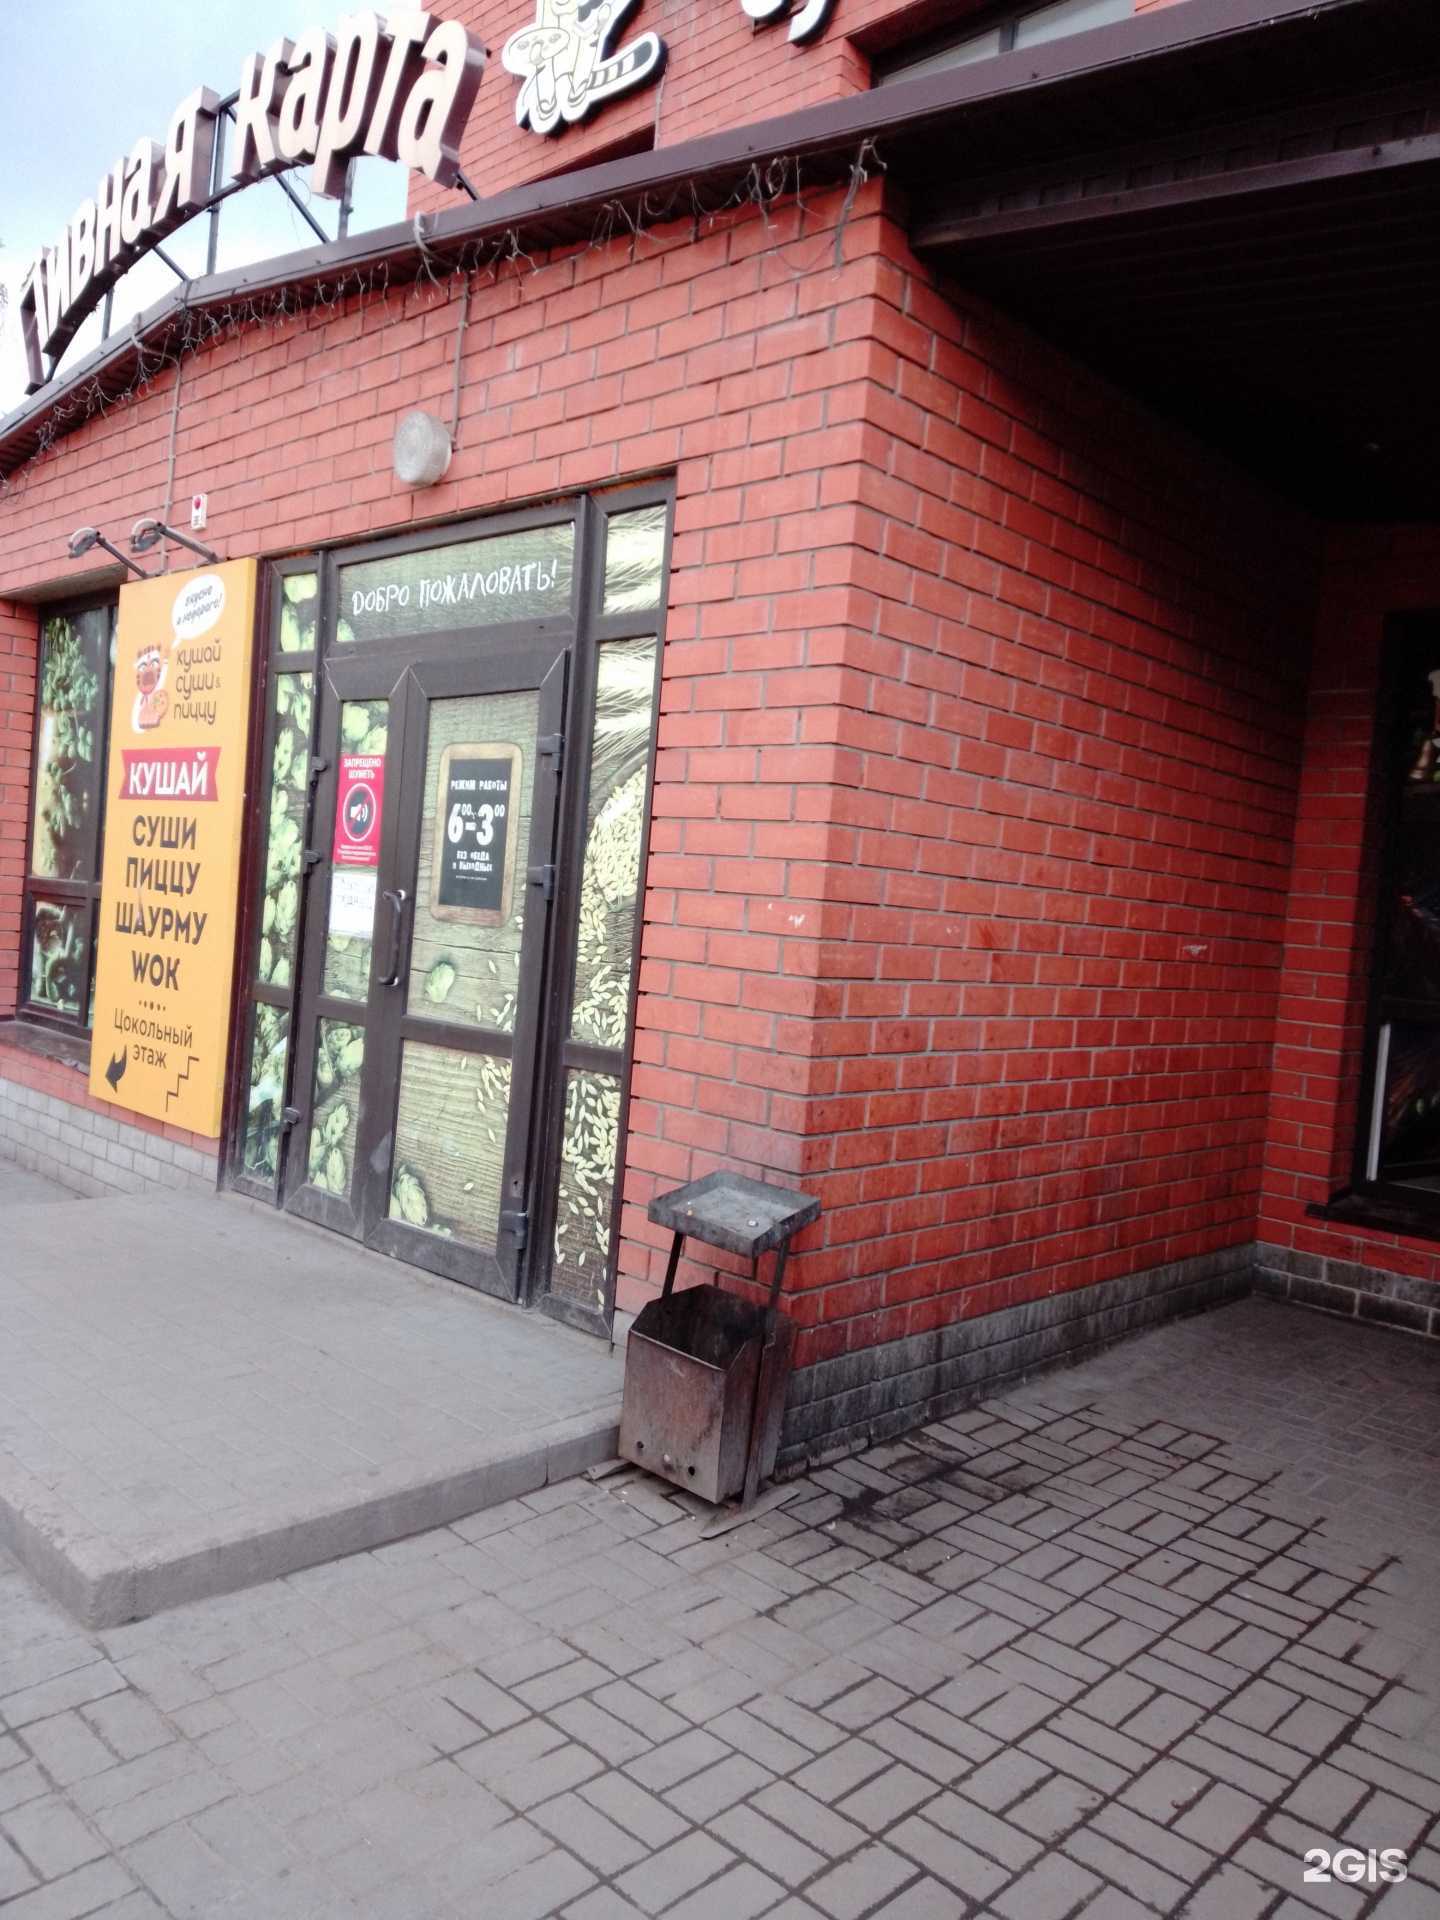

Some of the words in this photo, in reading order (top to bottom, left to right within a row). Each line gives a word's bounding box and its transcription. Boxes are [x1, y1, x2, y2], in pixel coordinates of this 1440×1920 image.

[351, 584, 410, 616] ДОБРО
[419, 559, 558, 608] ПОЖАЛОВАТЬ!
[176, 640, 221, 673] кушай
[173, 700, 217, 725] пиццу
[128, 751, 209, 796] КУШАЙ
[450, 779, 476, 791] РЕЖИМ
[132, 815, 197, 850] СУШИ
[125, 856, 201, 897] ПИЦЦУ
[114, 901, 208, 945] ШАУРМУ
[131, 950, 181, 991] WOK
[114, 1007, 193, 1049] Цокольный
[132, 1043, 167, 1069] этаж
